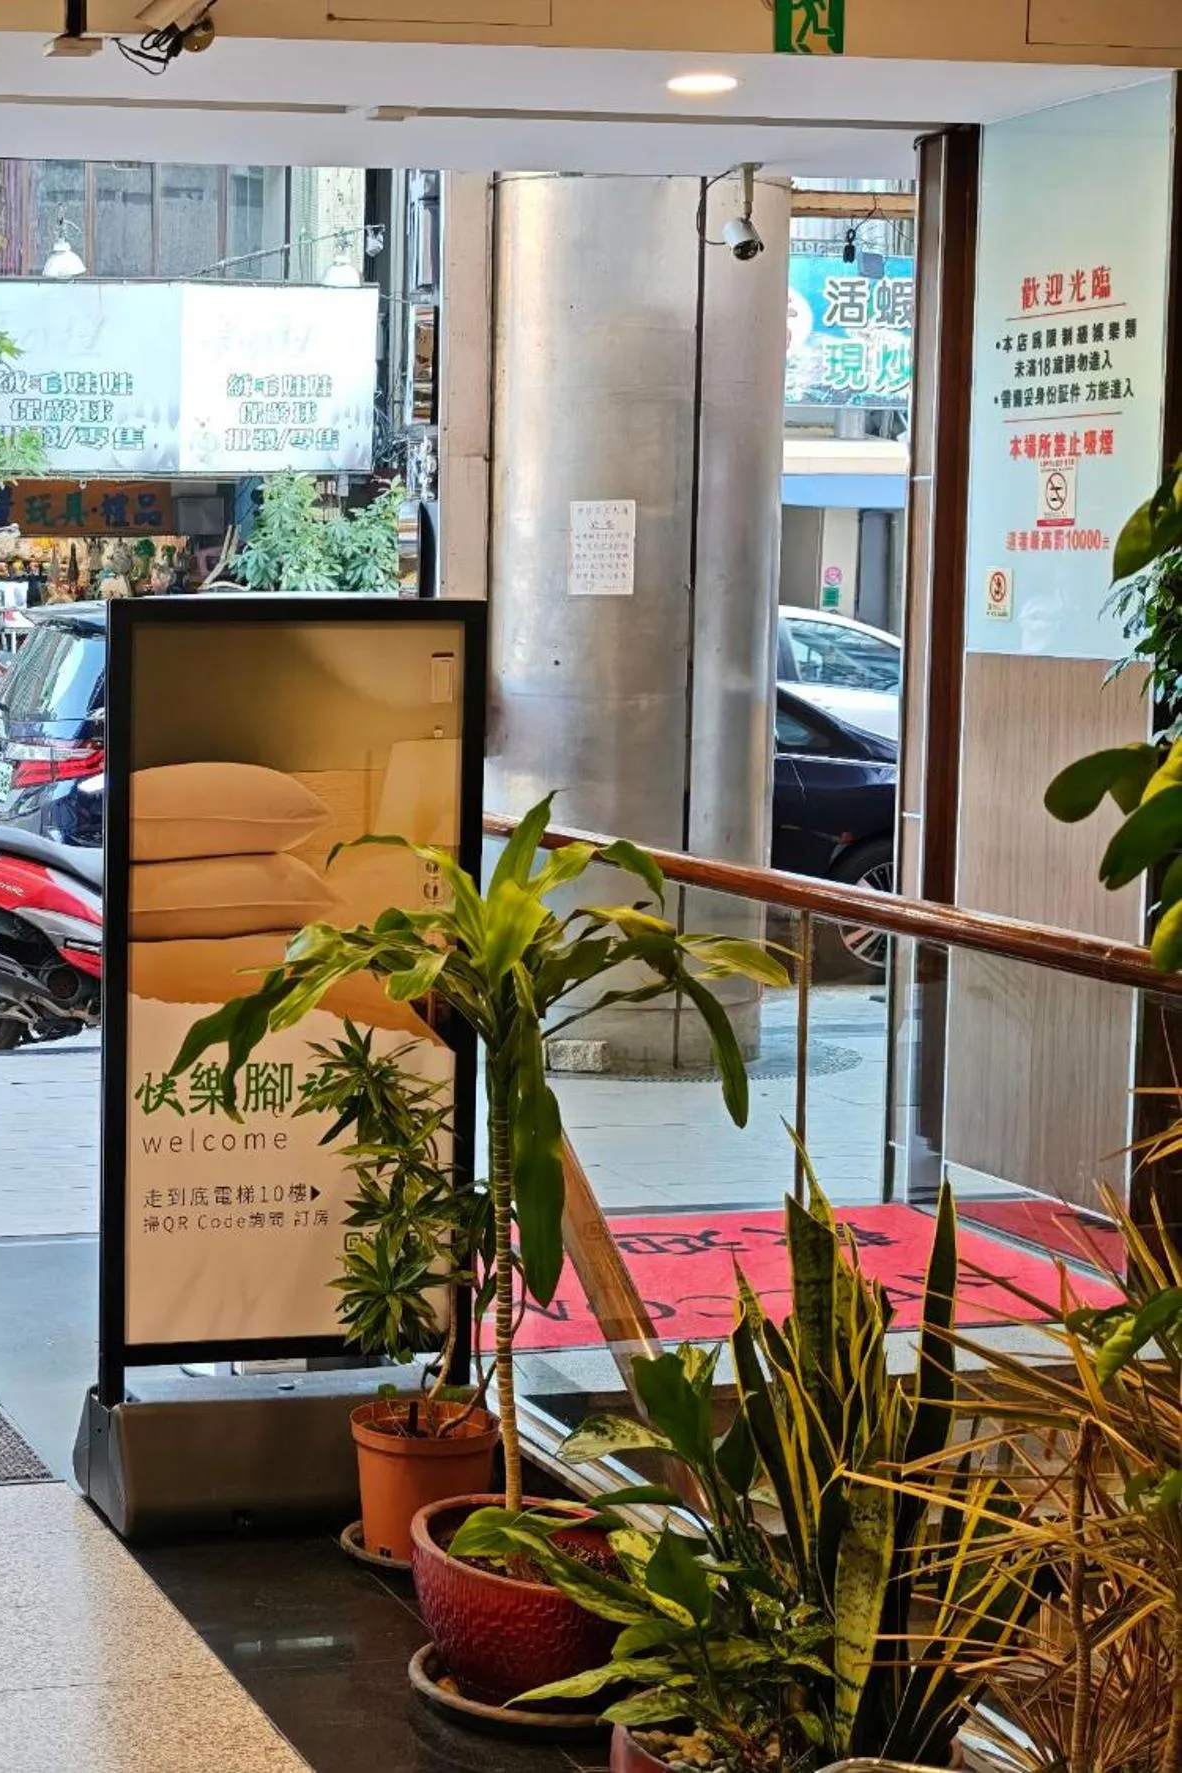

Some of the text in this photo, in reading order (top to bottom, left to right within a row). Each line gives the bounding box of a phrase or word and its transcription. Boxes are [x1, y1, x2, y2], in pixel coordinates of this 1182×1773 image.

[826, 279, 915, 325] 活蝦
[1021, 265, 1112, 310] 歡迎光臨
[825, 343, 913, 386] 現炒
[141, 1128, 289, 1155] welcome
[143, 1182, 308, 1209] 走到底電梯10樓
